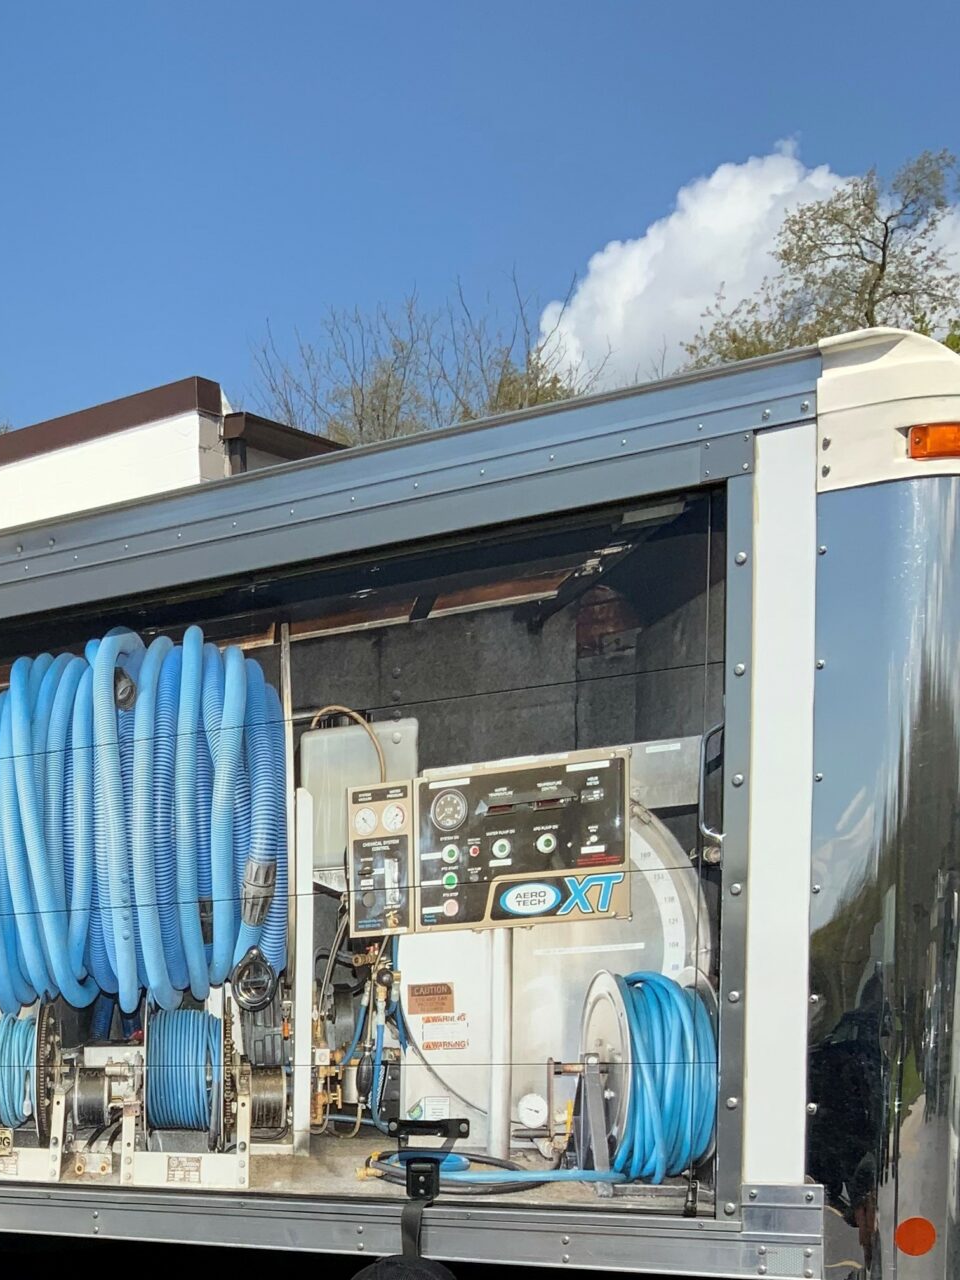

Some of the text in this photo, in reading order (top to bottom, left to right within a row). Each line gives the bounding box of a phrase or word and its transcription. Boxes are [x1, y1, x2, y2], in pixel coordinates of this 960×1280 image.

[515, 890, 546, 899] AERO
[556, 872, 624, 915] XT
[516, 898, 546, 906] TECH
[414, 985, 447, 995] CAUTION
